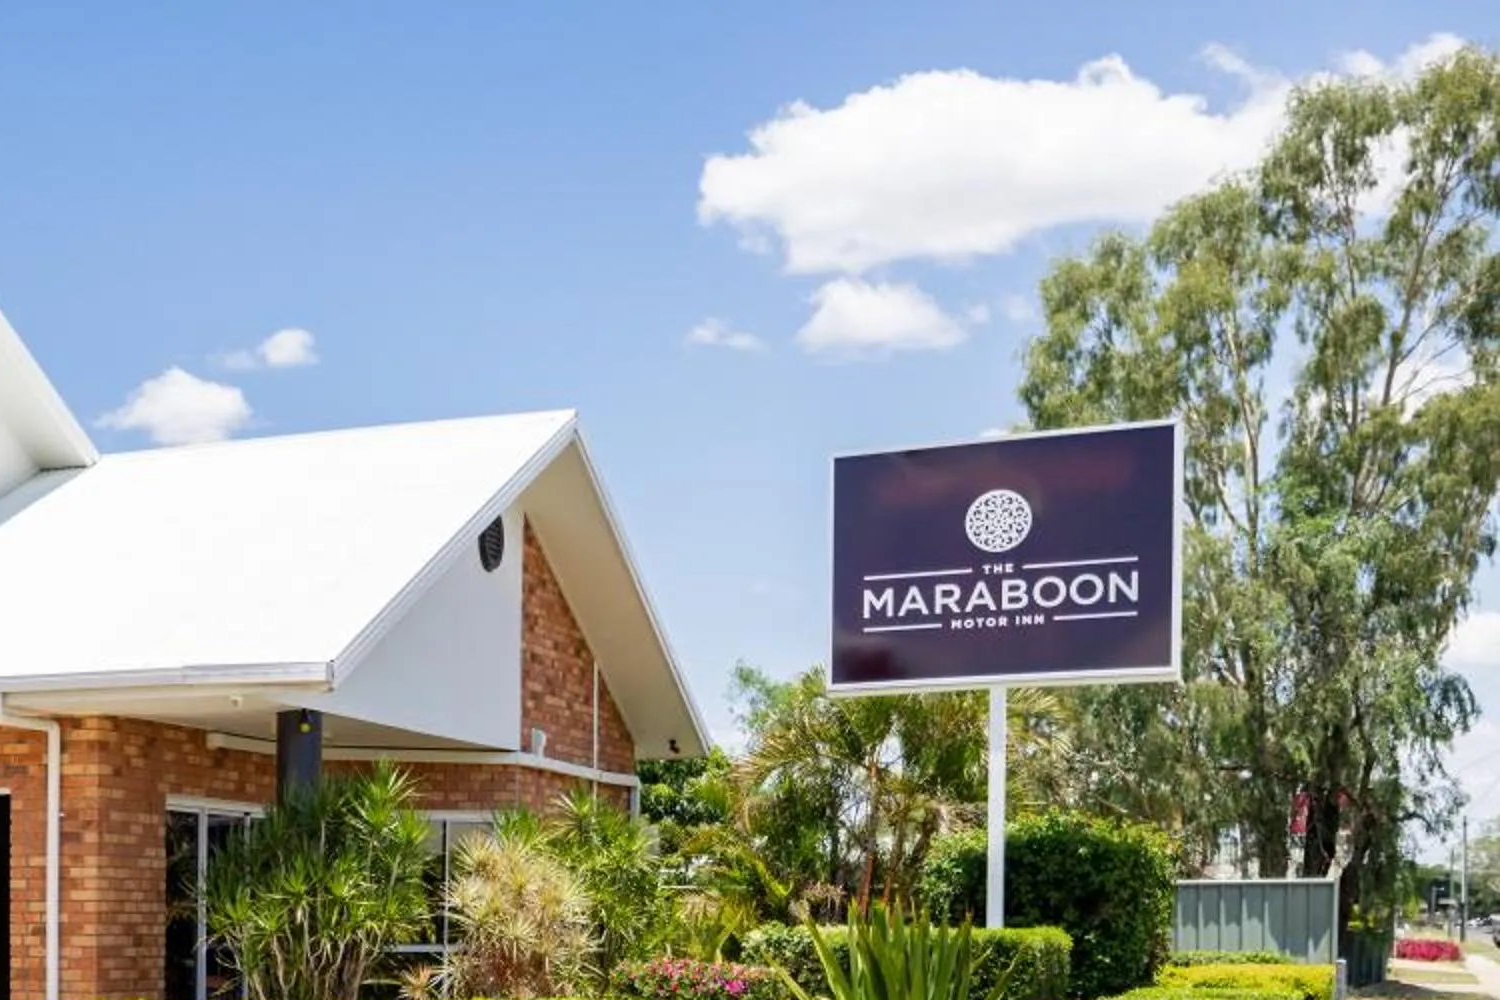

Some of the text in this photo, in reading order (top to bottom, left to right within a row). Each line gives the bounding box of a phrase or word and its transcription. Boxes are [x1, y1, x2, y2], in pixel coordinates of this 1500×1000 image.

[981, 563, 1014, 575] THE
[862, 570, 1140, 619] MARABOON
[950, 613, 1046, 630] MOTOR INN
